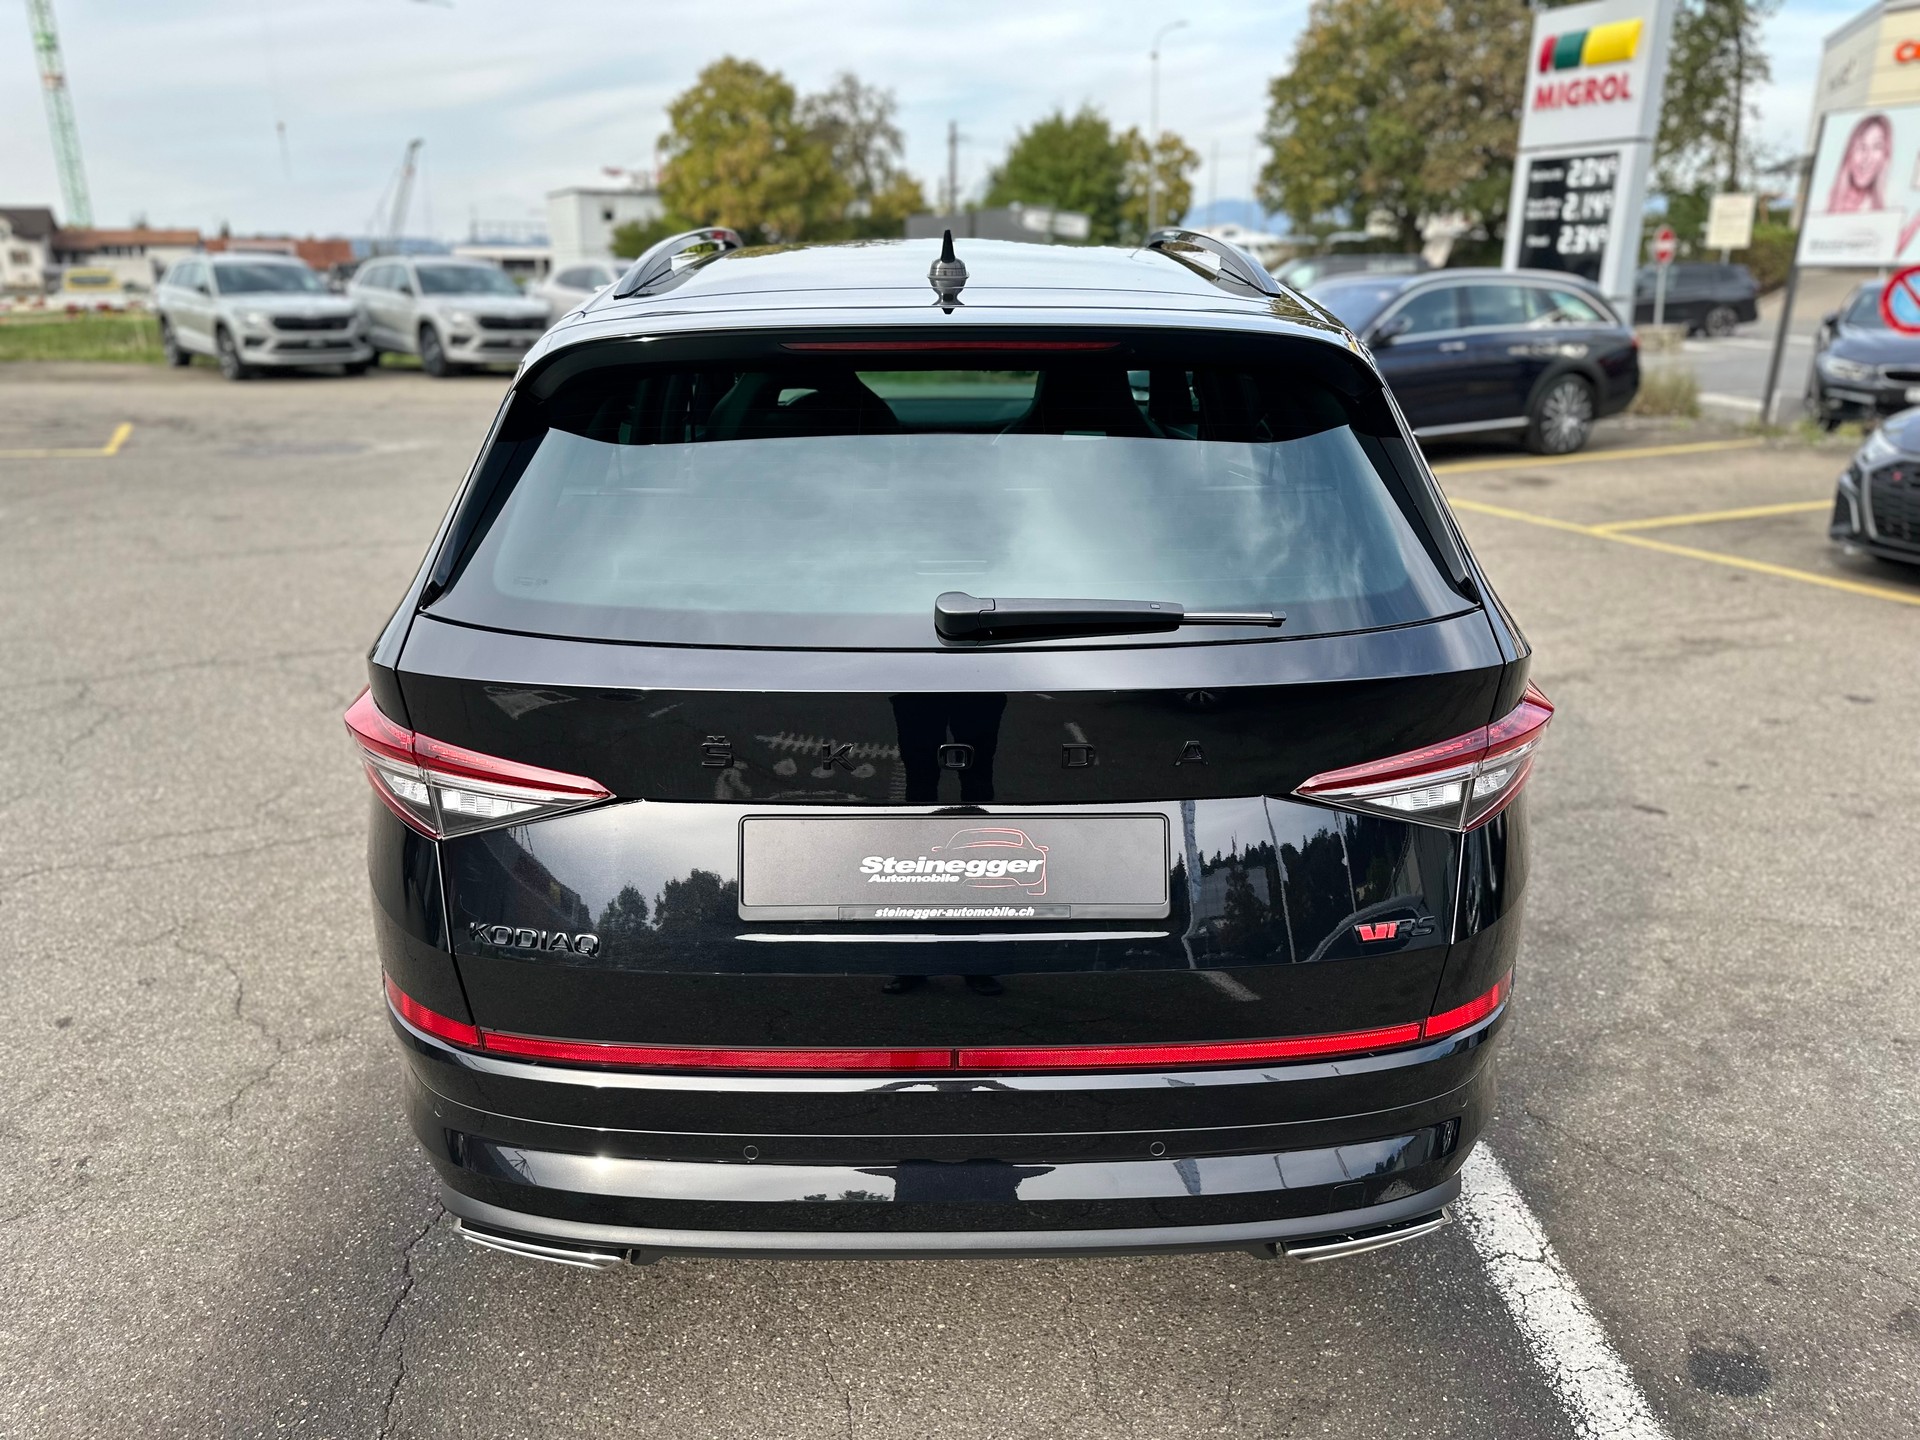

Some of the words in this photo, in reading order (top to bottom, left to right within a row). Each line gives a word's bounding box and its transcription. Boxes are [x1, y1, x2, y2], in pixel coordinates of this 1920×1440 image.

[1533, 74, 1631, 111] MIGROL
[859, 856, 1044, 877] Steinegger
[868, 873, 960, 883] Automobile
[874, 906, 1035, 920] steinegger-automobile.ch
[469, 921, 600, 958] KODIAQ
